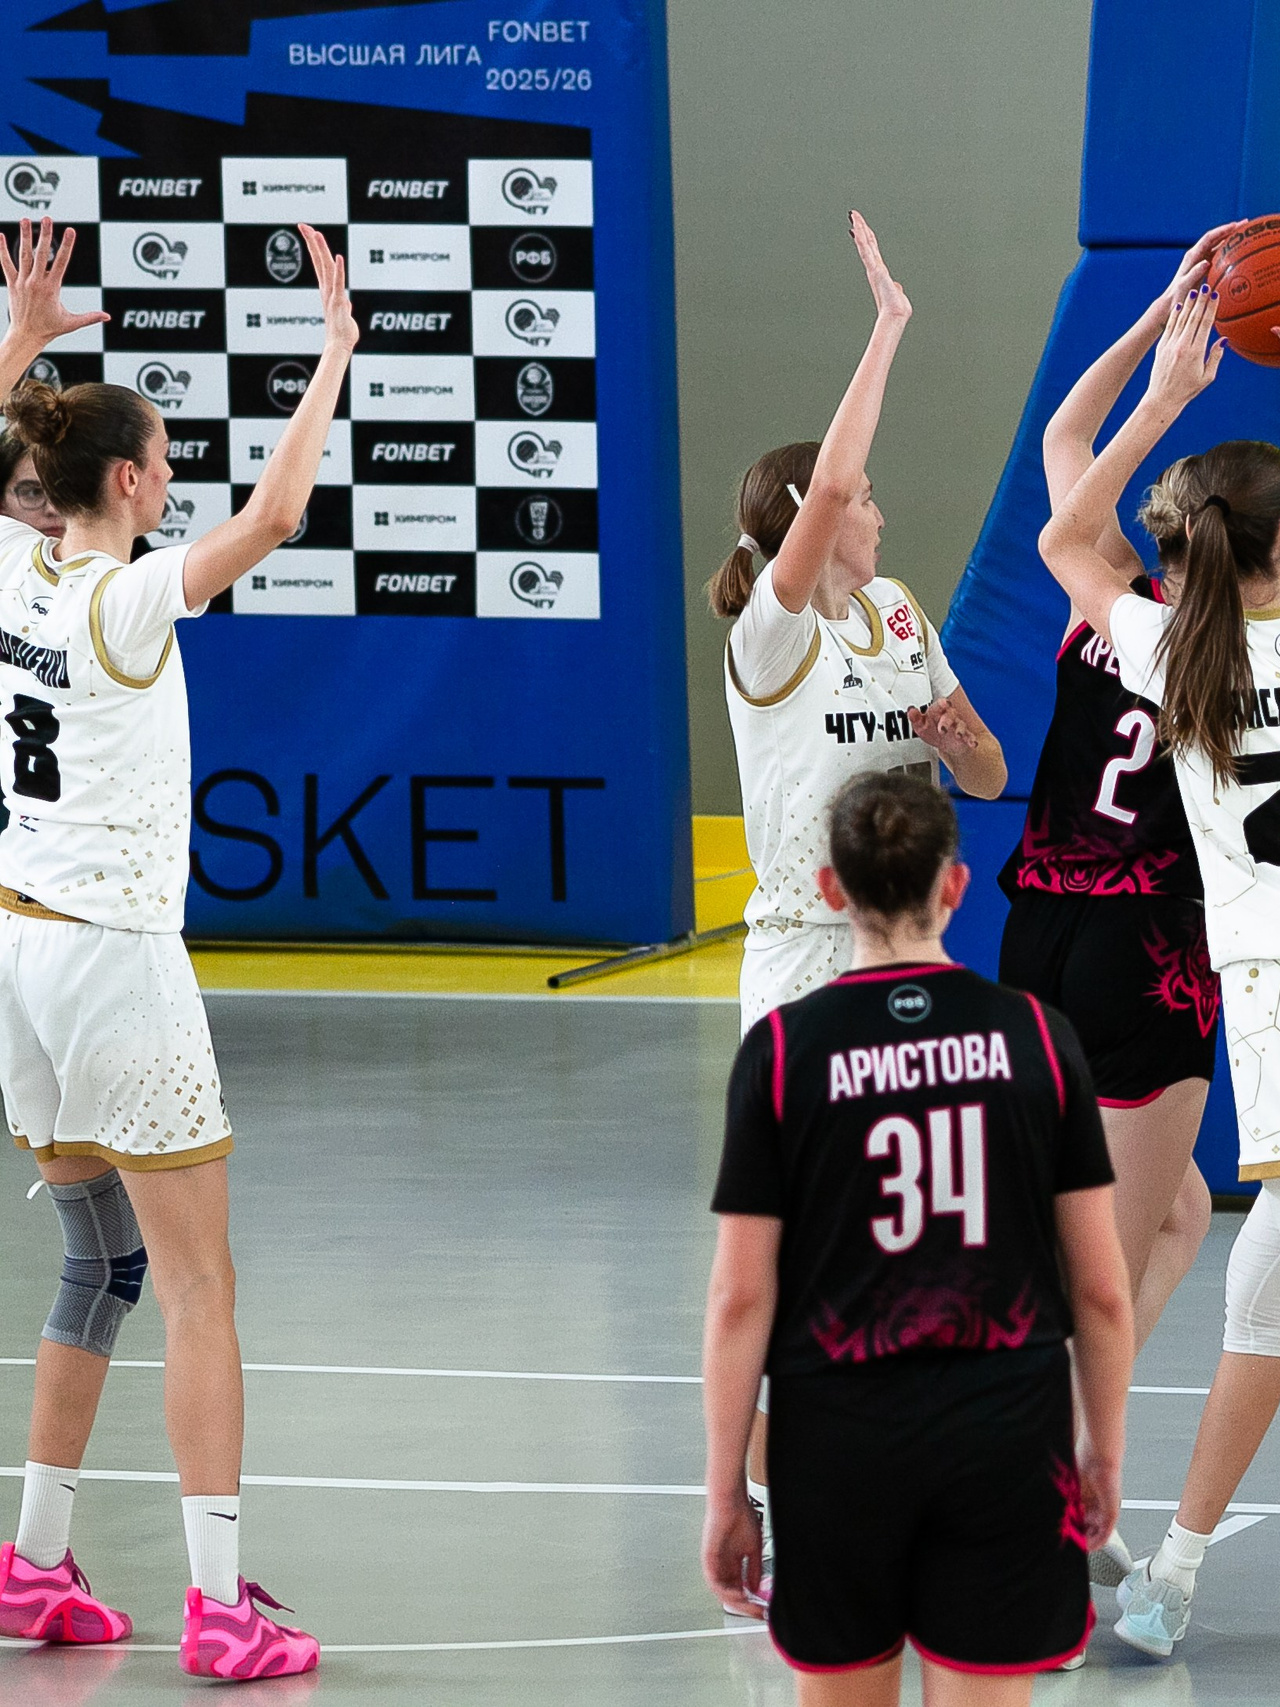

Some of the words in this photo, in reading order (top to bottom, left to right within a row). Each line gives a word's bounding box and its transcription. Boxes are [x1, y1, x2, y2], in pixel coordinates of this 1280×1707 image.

[488, 20, 590, 43] FONBET
[288, 43, 406, 66] ВЫСШАЯ
[415, 43, 483, 66] ЛИГА
[485, 67, 593, 92] 2025/26
[119, 178, 203, 198] FONBET
[367, 179, 450, 199] FONBET
[122, 309, 206, 329] FONBET
[369, 311, 452, 331] FONBET
[371, 442, 456, 463] FONBET
[374, 573, 457, 594] FONBET
[5, 693, 62, 803] 8
[1092, 708, 1158, 827] 2
[828, 1030, 1013, 1102] АРИСТОВА
[864, 1101, 989, 1255] 34
